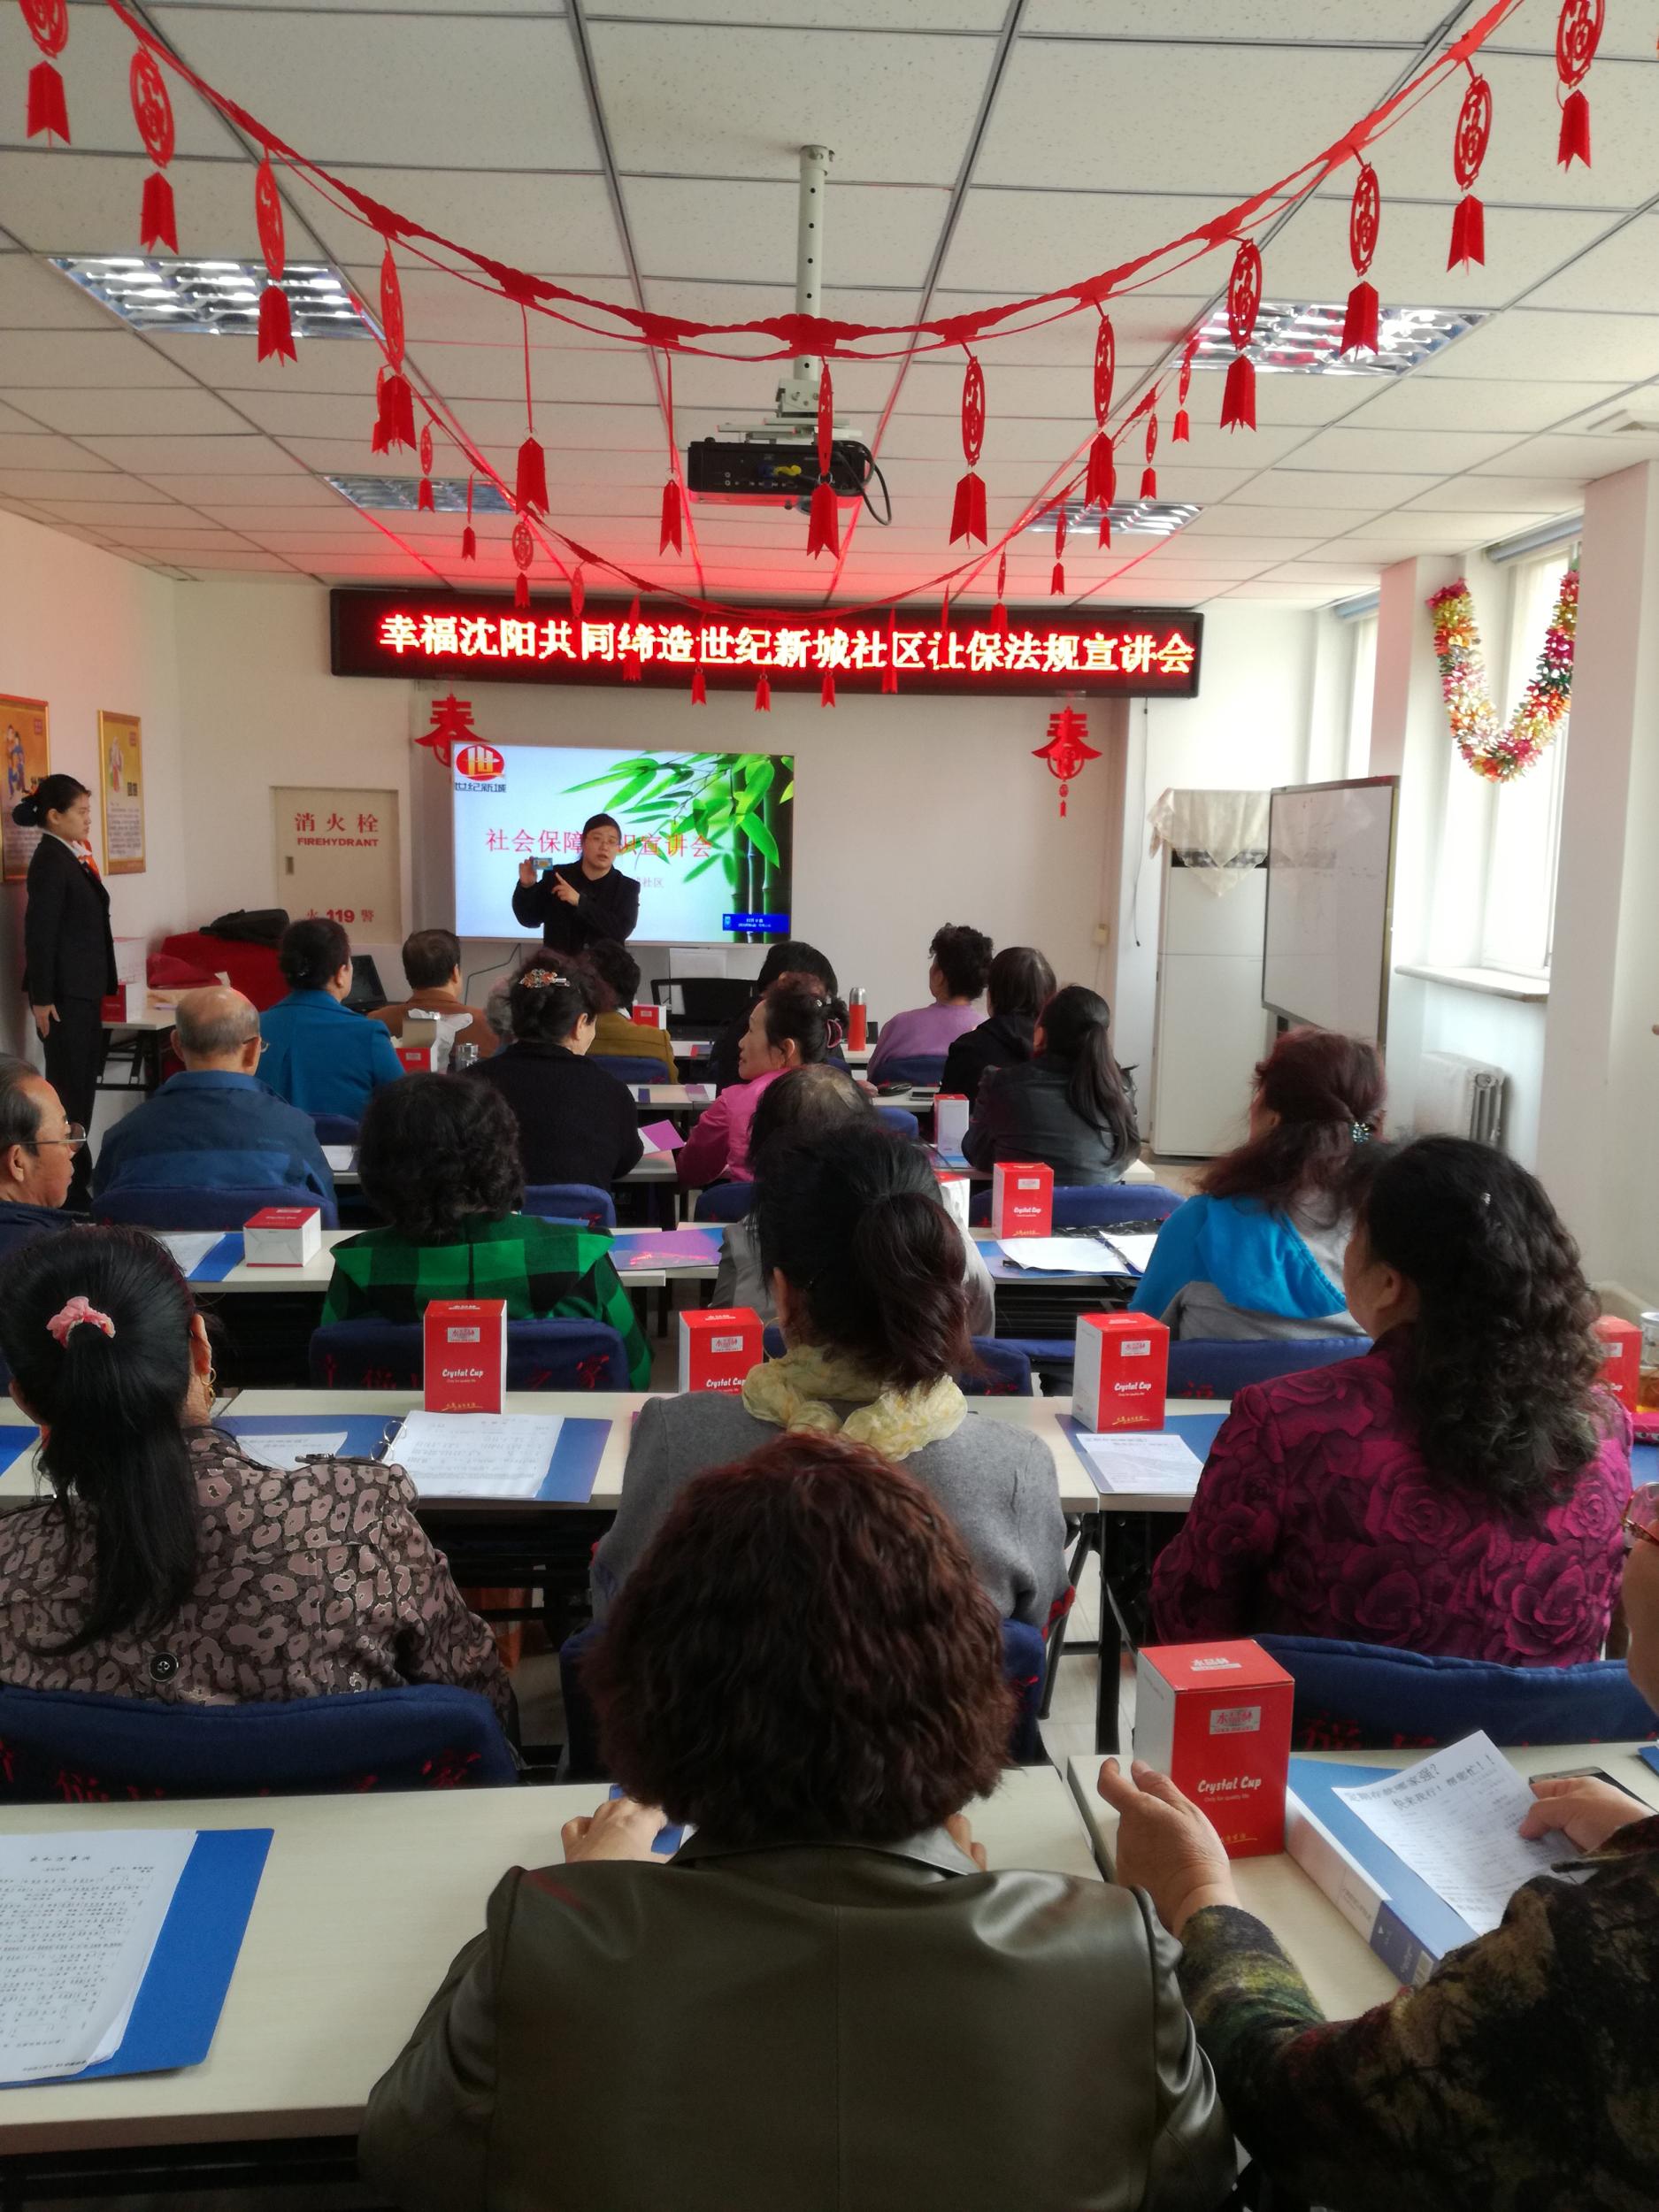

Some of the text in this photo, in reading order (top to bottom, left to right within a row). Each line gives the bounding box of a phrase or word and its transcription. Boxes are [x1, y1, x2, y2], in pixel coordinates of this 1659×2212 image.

[454, 782, 507, 793] 世纪新城
[294, 812, 379, 833] 消火栓
[297, 837, 380, 847] FIREHYDRANT
[486, 828, 713, 857] 社会保障识宣讲会
[326, 909, 355, 923] 119
[442, 1368, 484, 1379] Crystal Cup
[706, 1378, 732, 1388] Crystal
[1114, 1381, 1152, 1393] Crystal Cup
[1197, 1776, 1262, 1794] Crystal Cup
